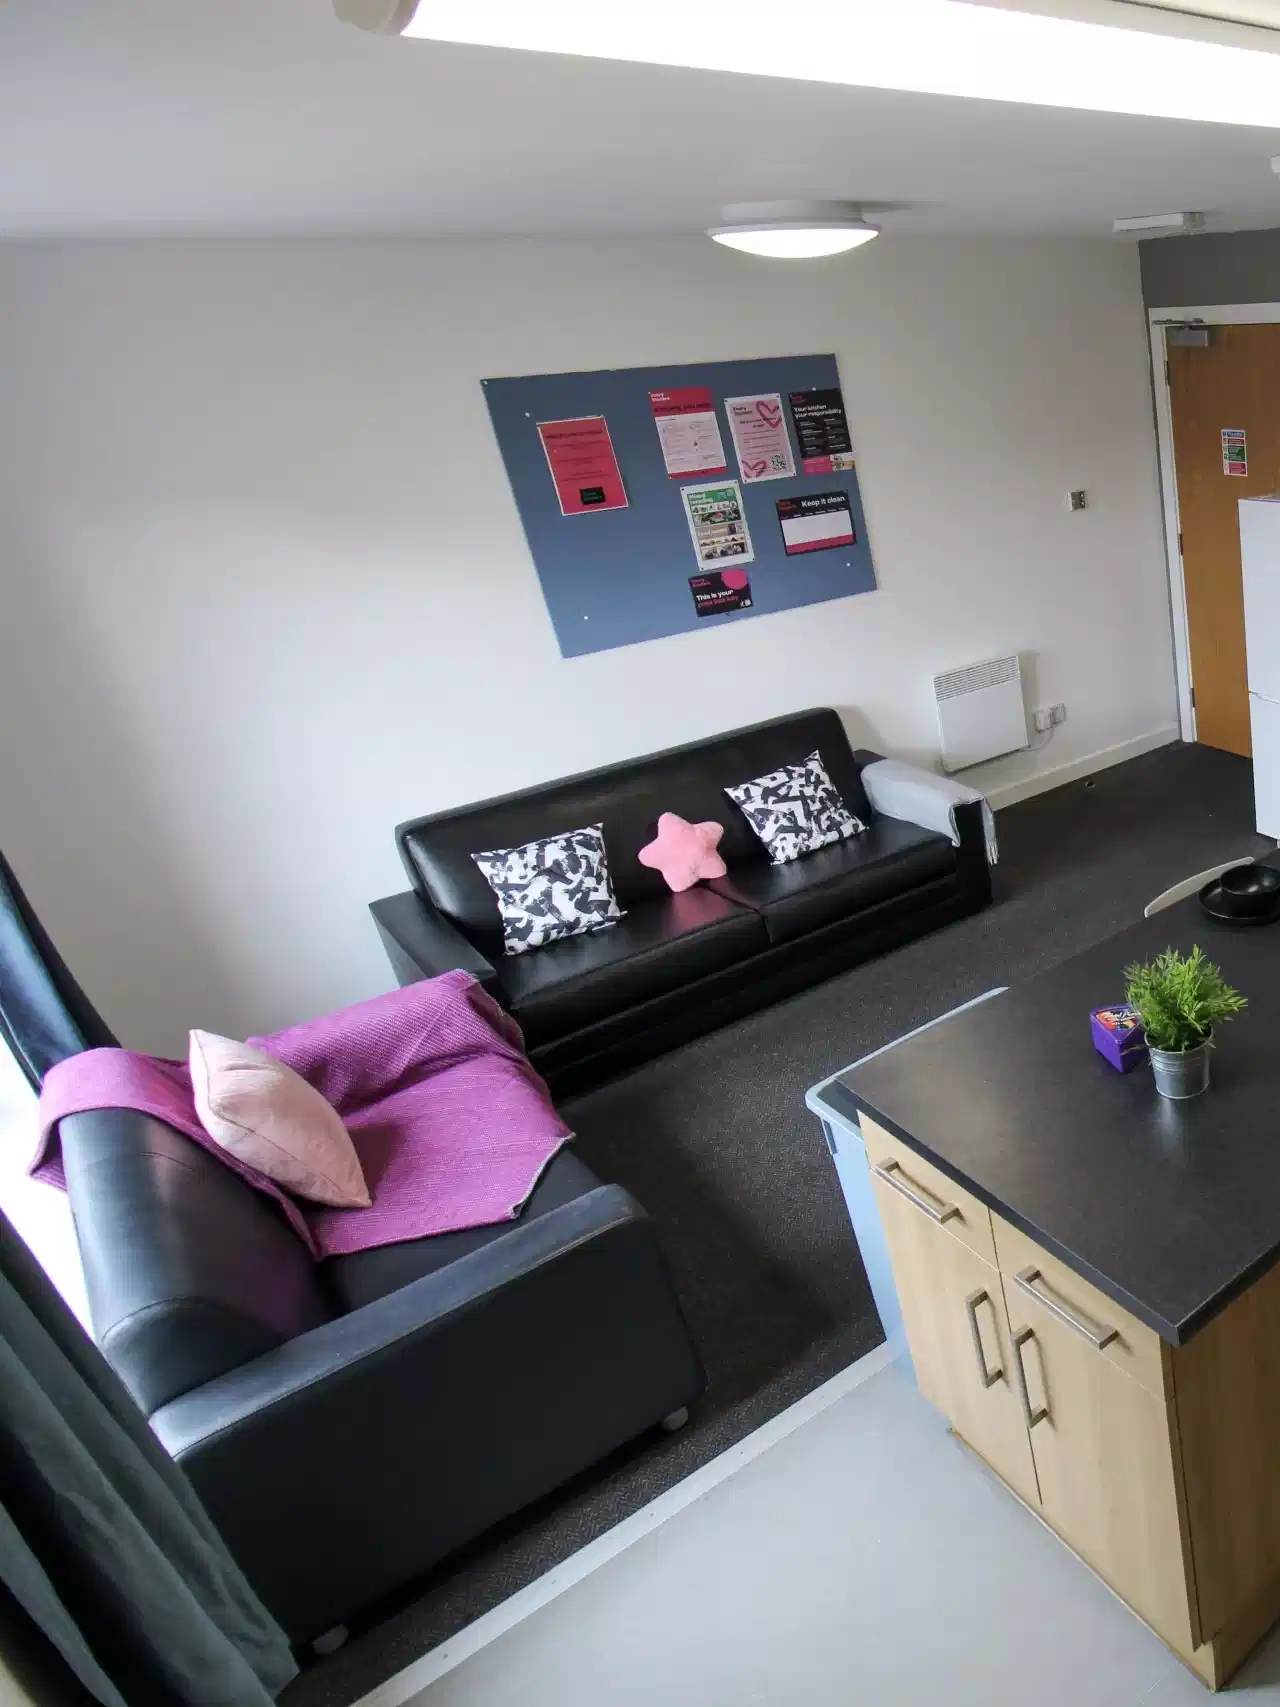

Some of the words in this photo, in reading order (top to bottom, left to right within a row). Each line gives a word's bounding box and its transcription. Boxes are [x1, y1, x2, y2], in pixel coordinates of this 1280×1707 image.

[801, 500, 820, 508] Keep
[827, 496, 845, 504] clean
[718, 590, 734, 598] your
